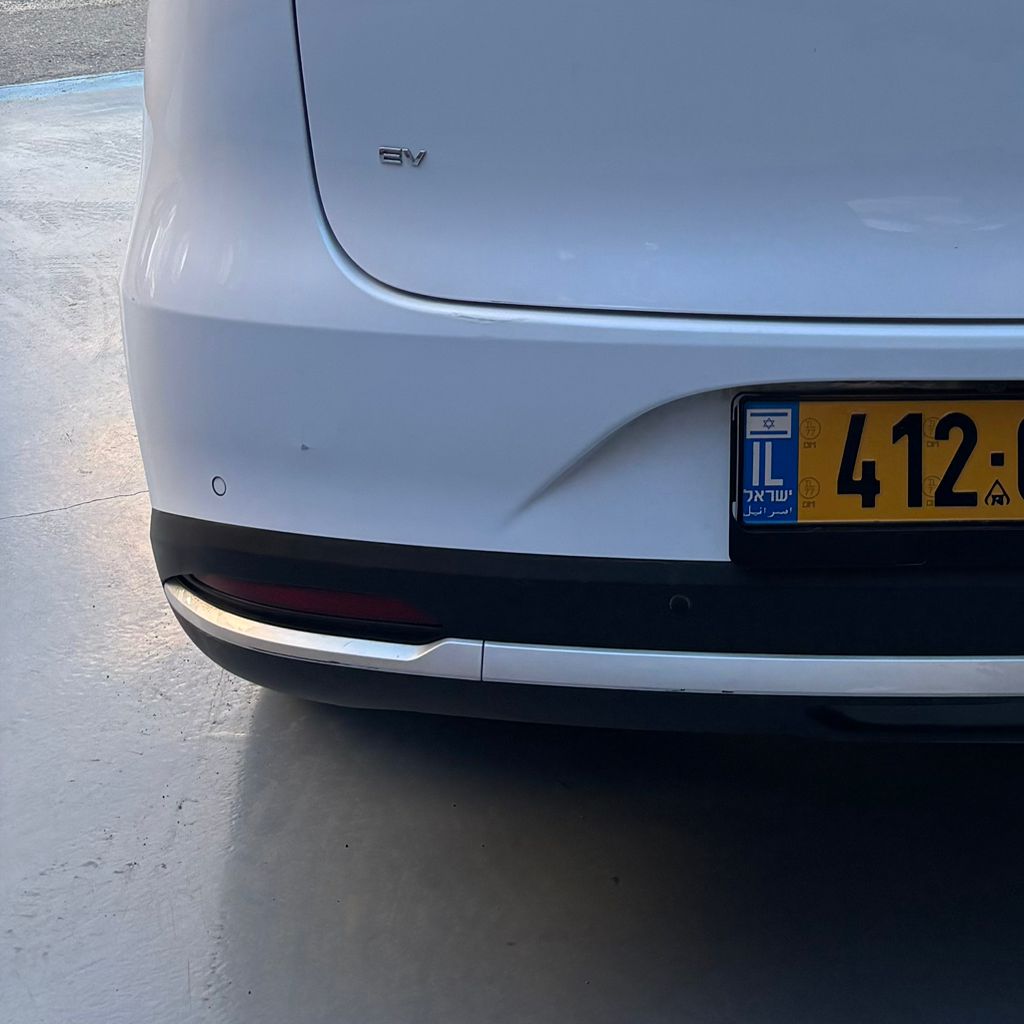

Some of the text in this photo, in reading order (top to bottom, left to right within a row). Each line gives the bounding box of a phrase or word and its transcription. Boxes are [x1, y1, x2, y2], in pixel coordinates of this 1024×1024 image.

[379, 146, 427, 168] EV
[752, 441, 784, 487] IL
[742, 488, 793, 503] ישראל
